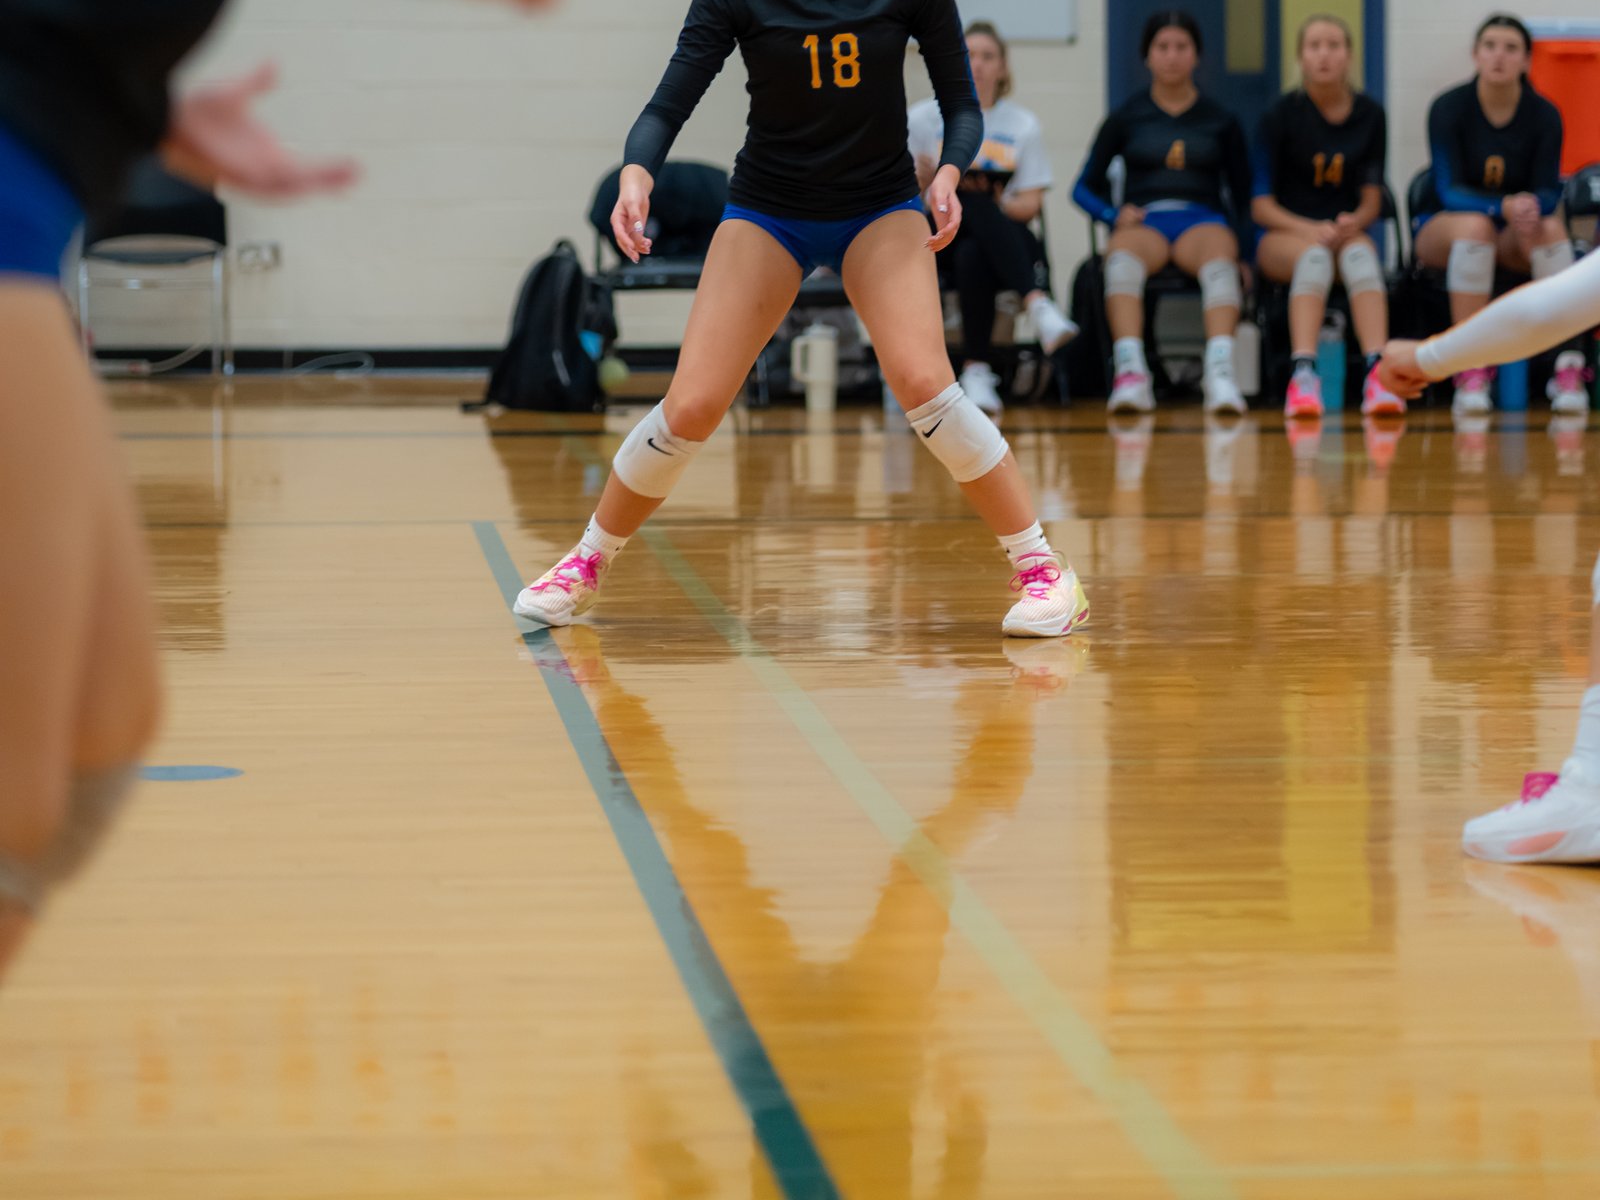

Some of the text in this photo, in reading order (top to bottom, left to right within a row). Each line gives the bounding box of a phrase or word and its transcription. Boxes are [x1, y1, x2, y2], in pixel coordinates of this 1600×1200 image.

[802, 32, 861, 89] 18
[1165, 139, 1186, 170] 4
[1312, 152, 1345, 187] 14
